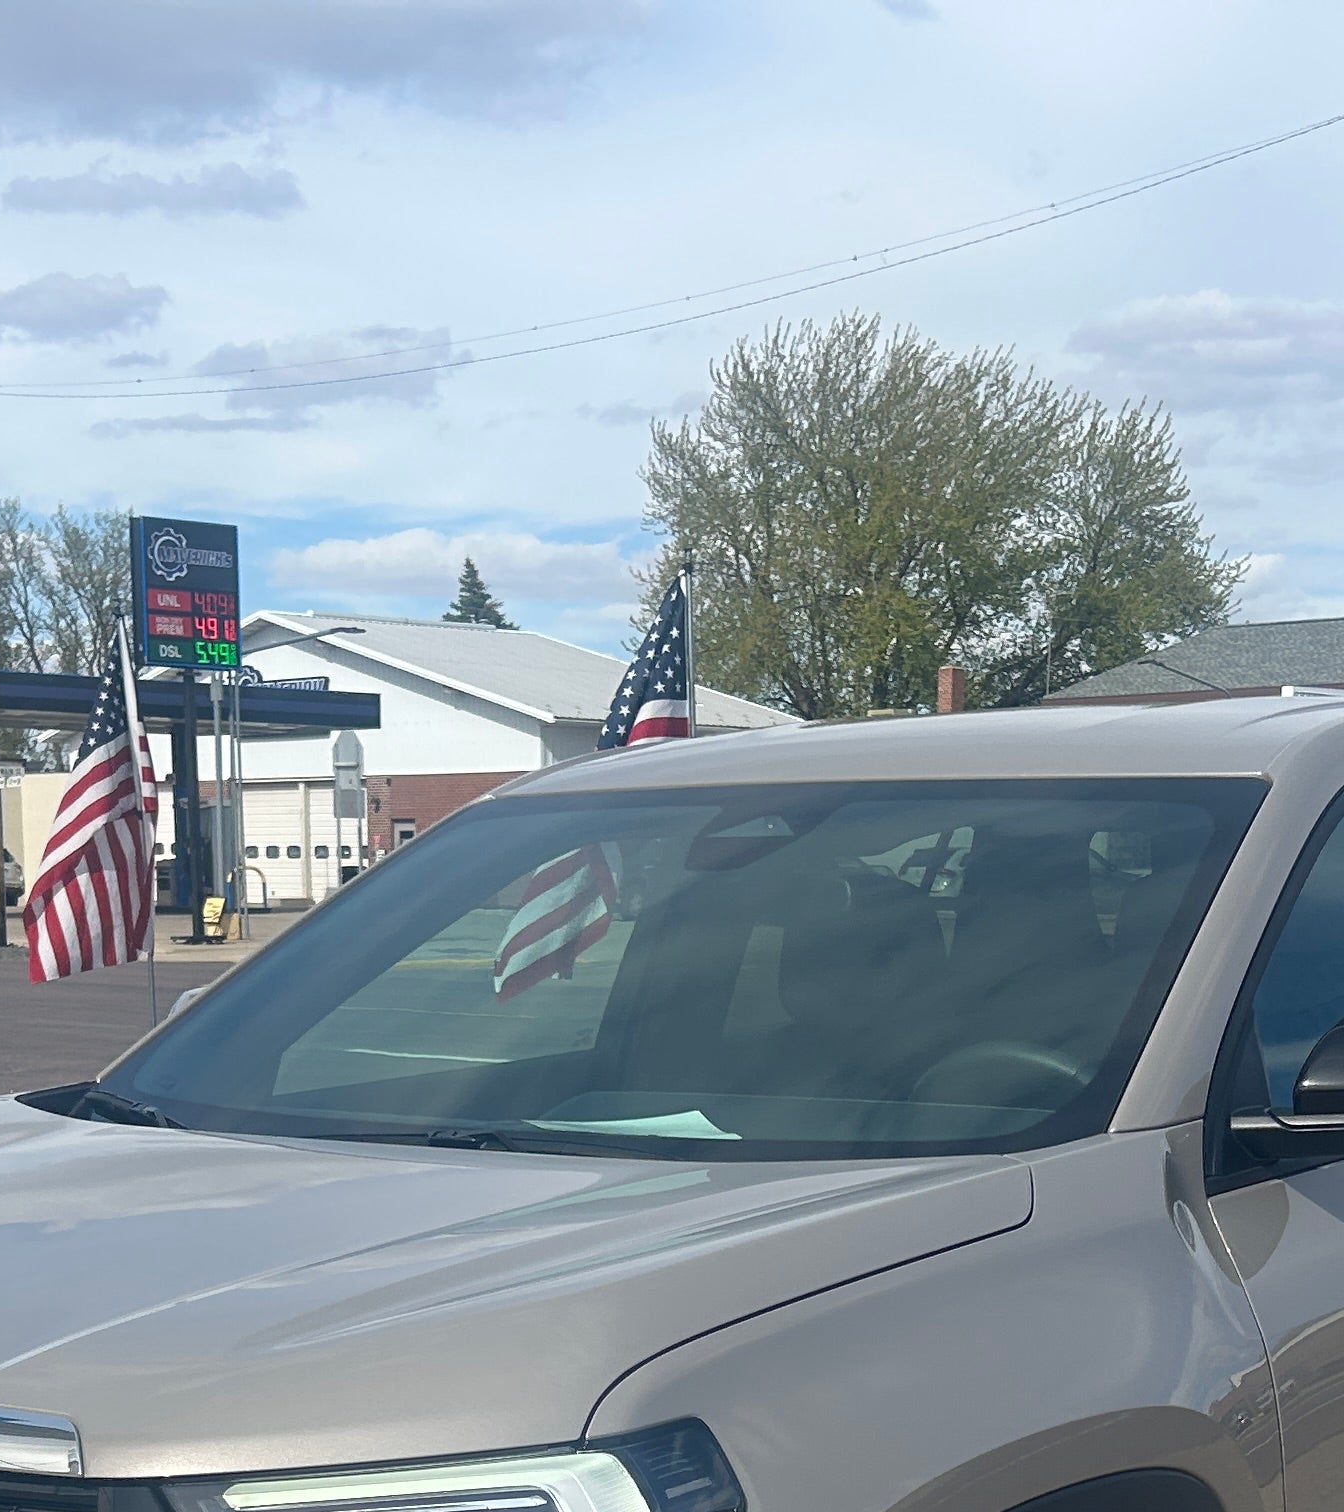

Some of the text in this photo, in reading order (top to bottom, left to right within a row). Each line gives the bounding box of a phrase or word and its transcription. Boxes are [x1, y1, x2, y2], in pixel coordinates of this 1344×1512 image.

[157, 593, 181, 607] UNL
[156, 624, 184, 636] PREM
[159, 644, 182, 658] DSL
